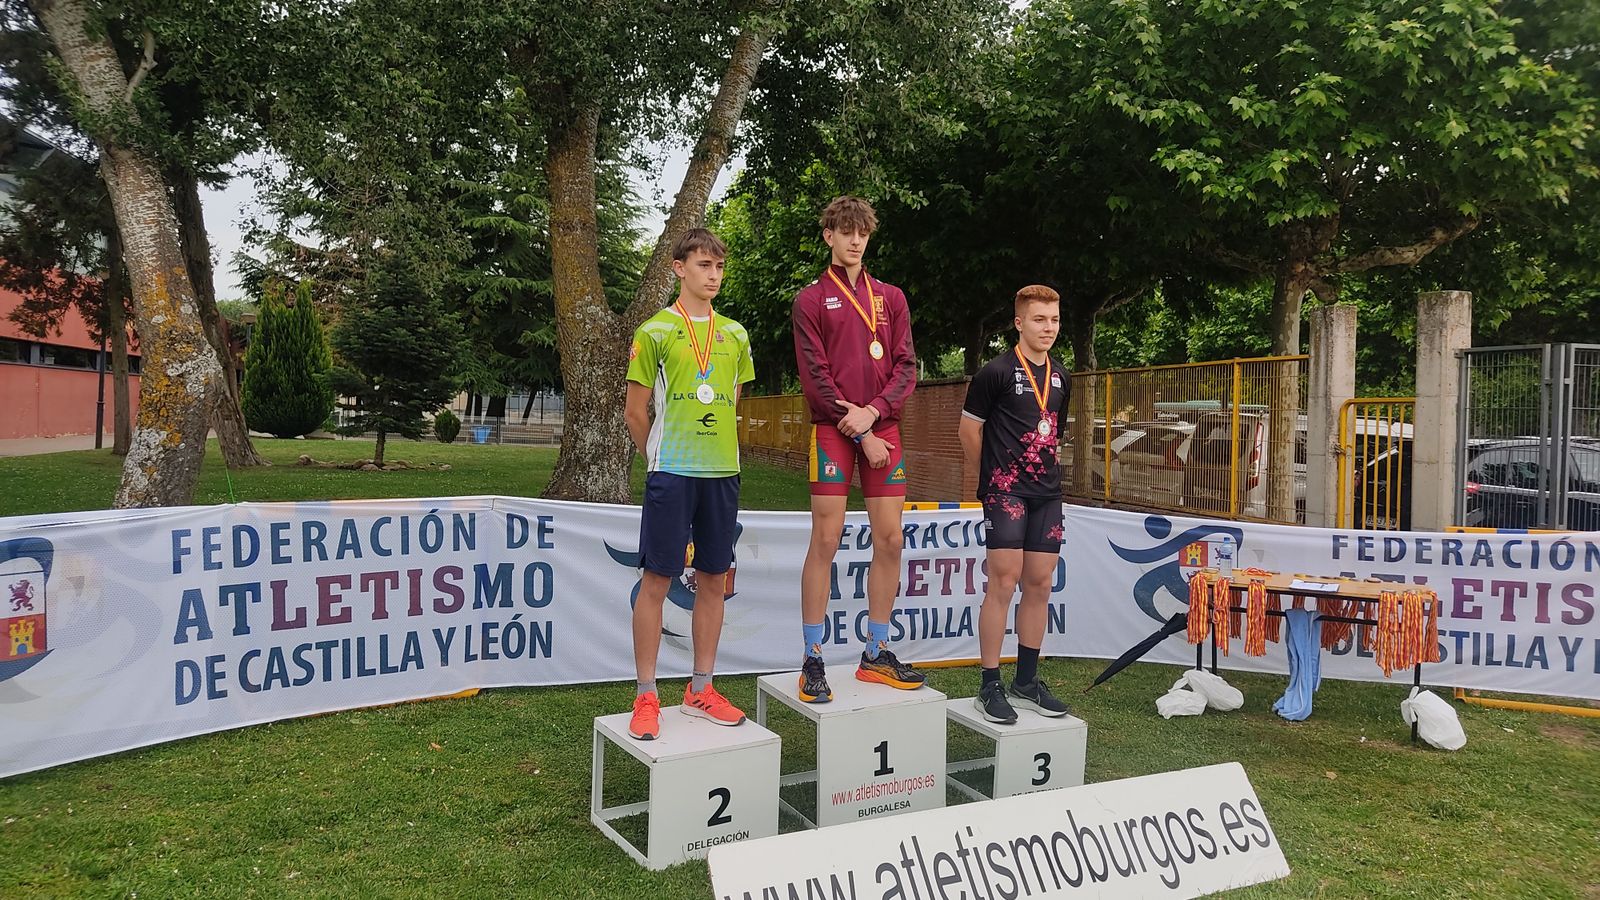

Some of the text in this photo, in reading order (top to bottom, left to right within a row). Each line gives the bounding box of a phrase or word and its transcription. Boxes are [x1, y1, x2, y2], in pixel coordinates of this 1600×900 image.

[172, 509, 555, 575] FEDERACIÓN DE
[174, 561, 554, 644] ATLETISMO
[854, 605, 974, 643] CSTILLA
[175, 613, 553, 706] DE CASTILLA Y LEÓN
[1558, 635, 1584, 672] Y
[874, 740, 894, 777] 1
[1031, 752, 1051, 786] 3
[707, 787, 732, 827] 2
[858, 800, 911, 818] BURGALESA
[687, 829, 750, 852] DELEGACIÓN
